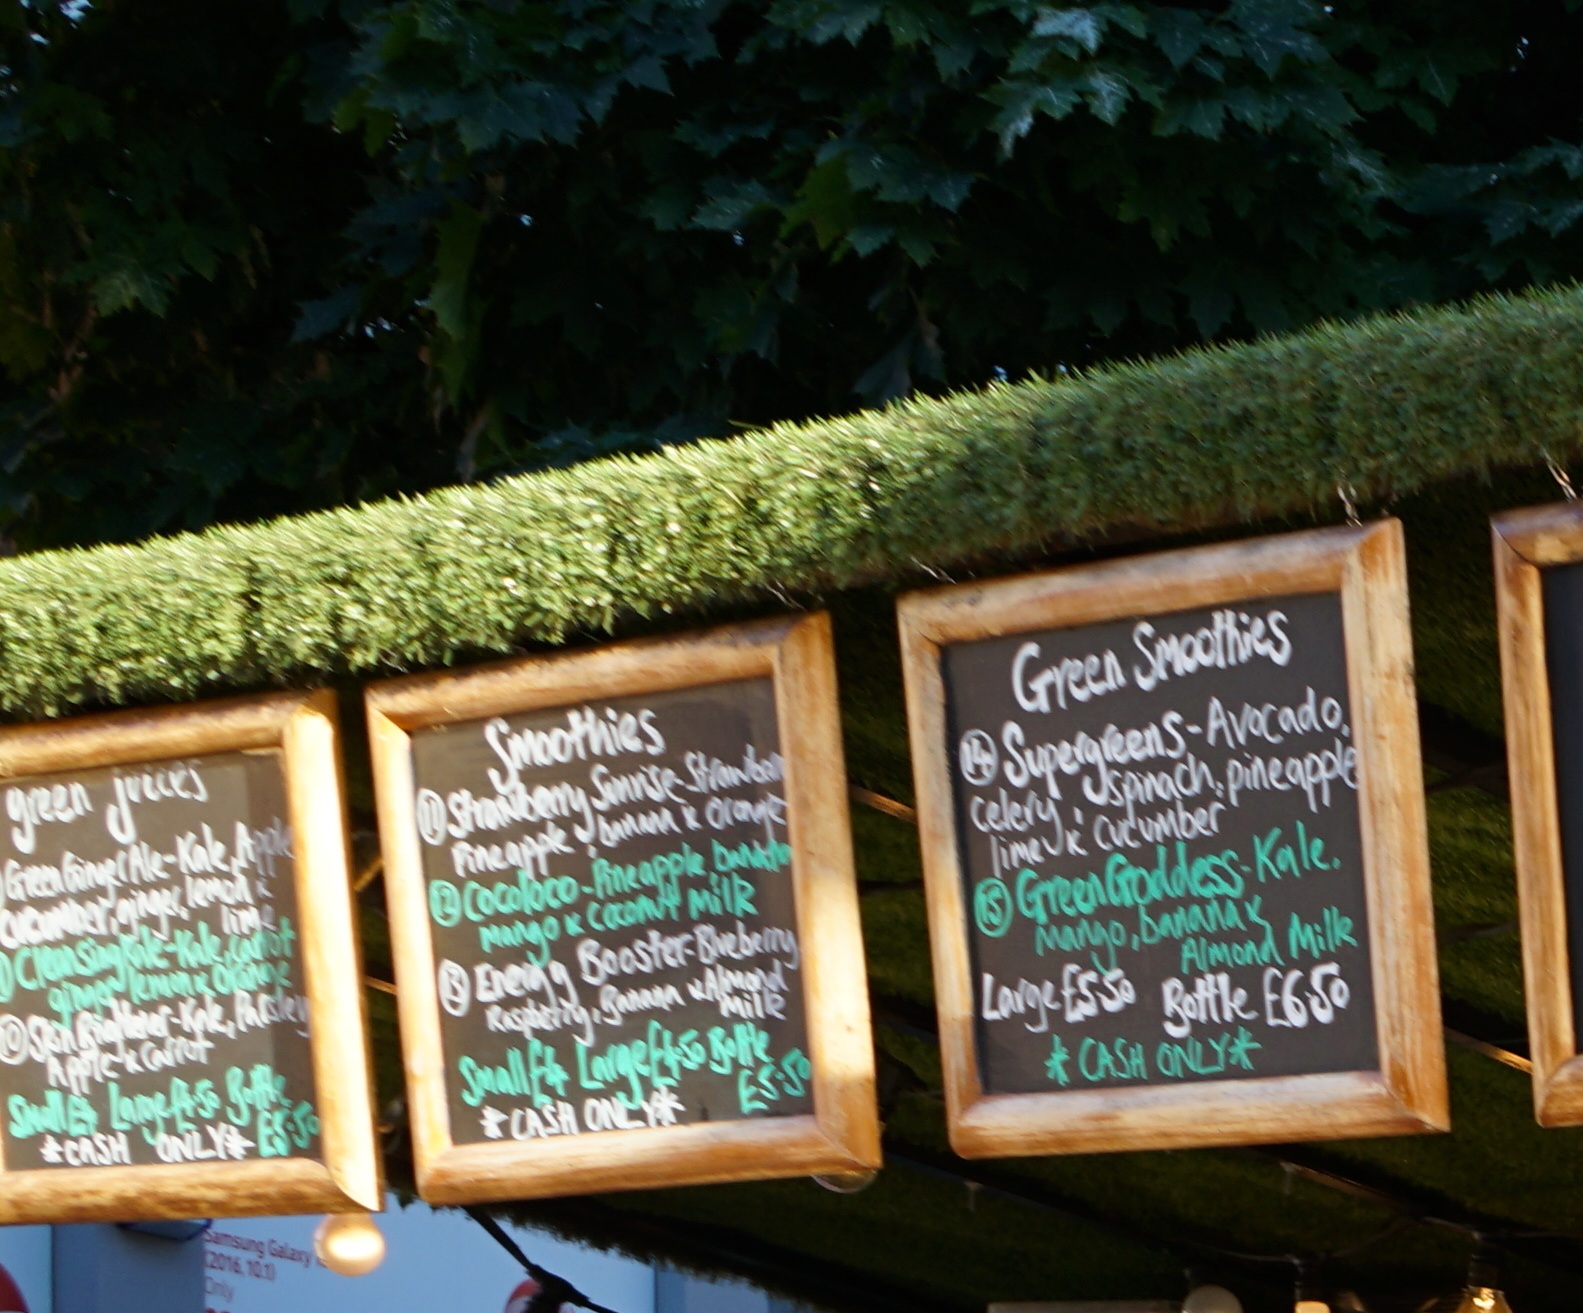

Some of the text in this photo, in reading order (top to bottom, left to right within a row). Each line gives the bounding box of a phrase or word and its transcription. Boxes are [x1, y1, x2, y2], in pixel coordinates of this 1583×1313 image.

[1011, 609, 1293, 714] Green Smoothies
[484, 705, 665, 792] Smoothies
[990, 800, 1226, 879] lime cucumber
[1015, 868, 1098, 924] Green
[1181, 906, 1358, 975] Almond Milk
[982, 971, 1061, 1033] Large
[1162, 972, 1258, 1038] Bottle
[576, 1040, 652, 1112] Large
[706, 1021, 774, 1075] Bottle
[204, 1229, 312, 1268] Samsung Galaxy
